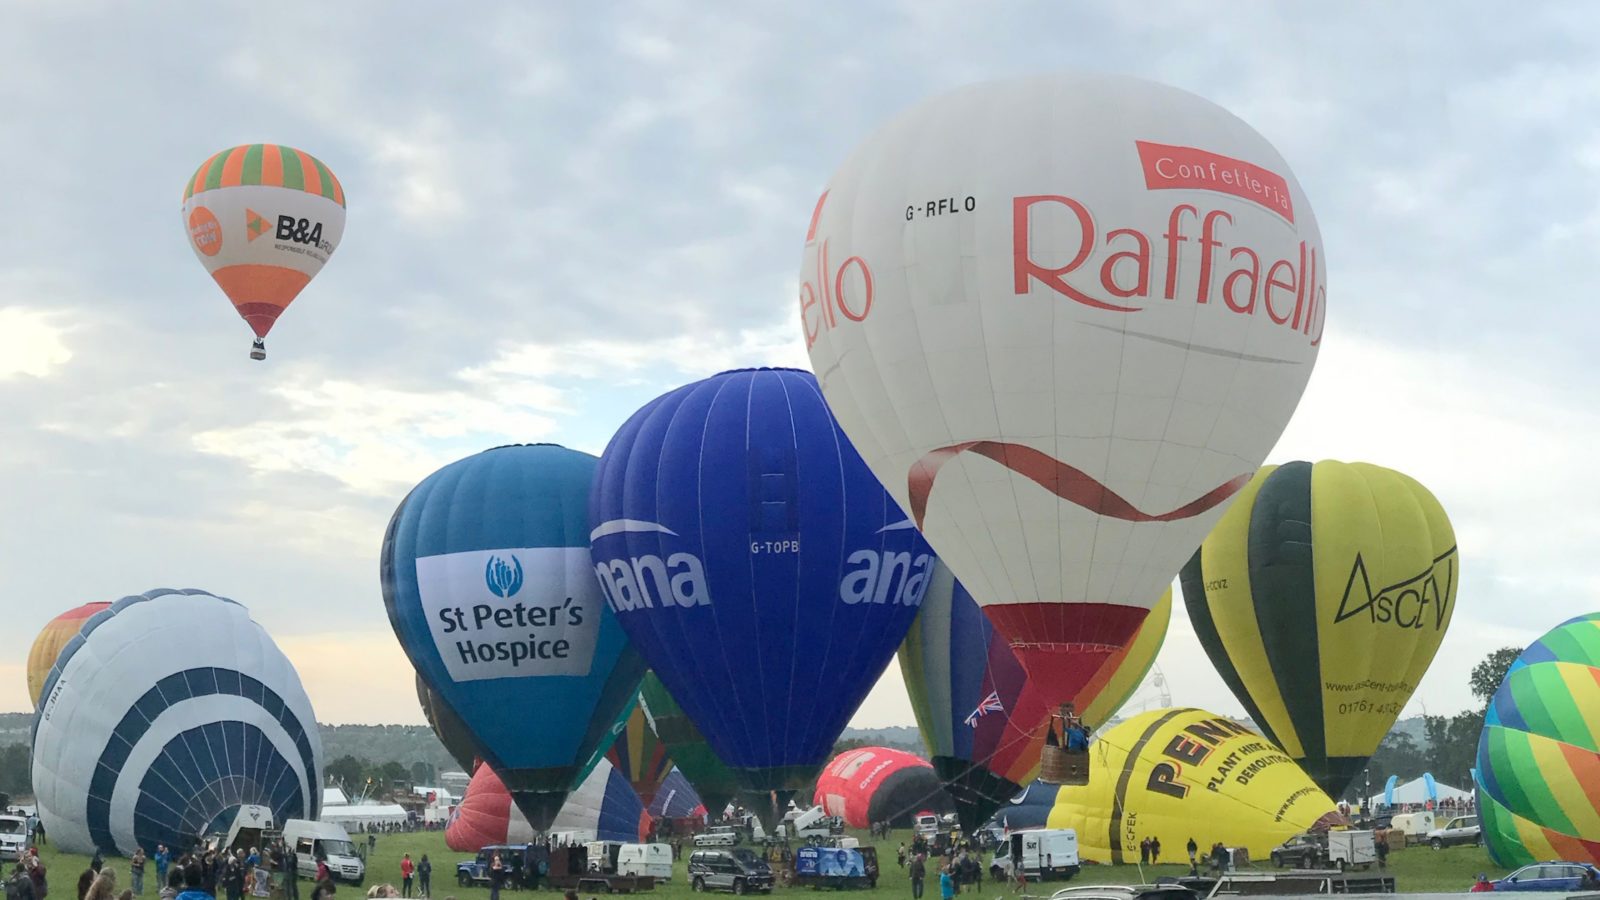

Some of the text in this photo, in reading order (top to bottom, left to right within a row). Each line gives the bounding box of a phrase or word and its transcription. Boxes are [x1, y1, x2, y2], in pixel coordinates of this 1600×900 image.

[1155, 157, 1289, 210] Confetteria
[906, 196, 976, 221] G-RFLO
[276, 215, 322, 251] B&A
[1013, 195, 1327, 346] Raffaello
[751, 540, 799, 554] G-TOPB
[439, 597, 583, 633] St Peter's
[456, 633, 570, 667] Hospice
[1206, 742, 1267, 793] PLANT HIRE
